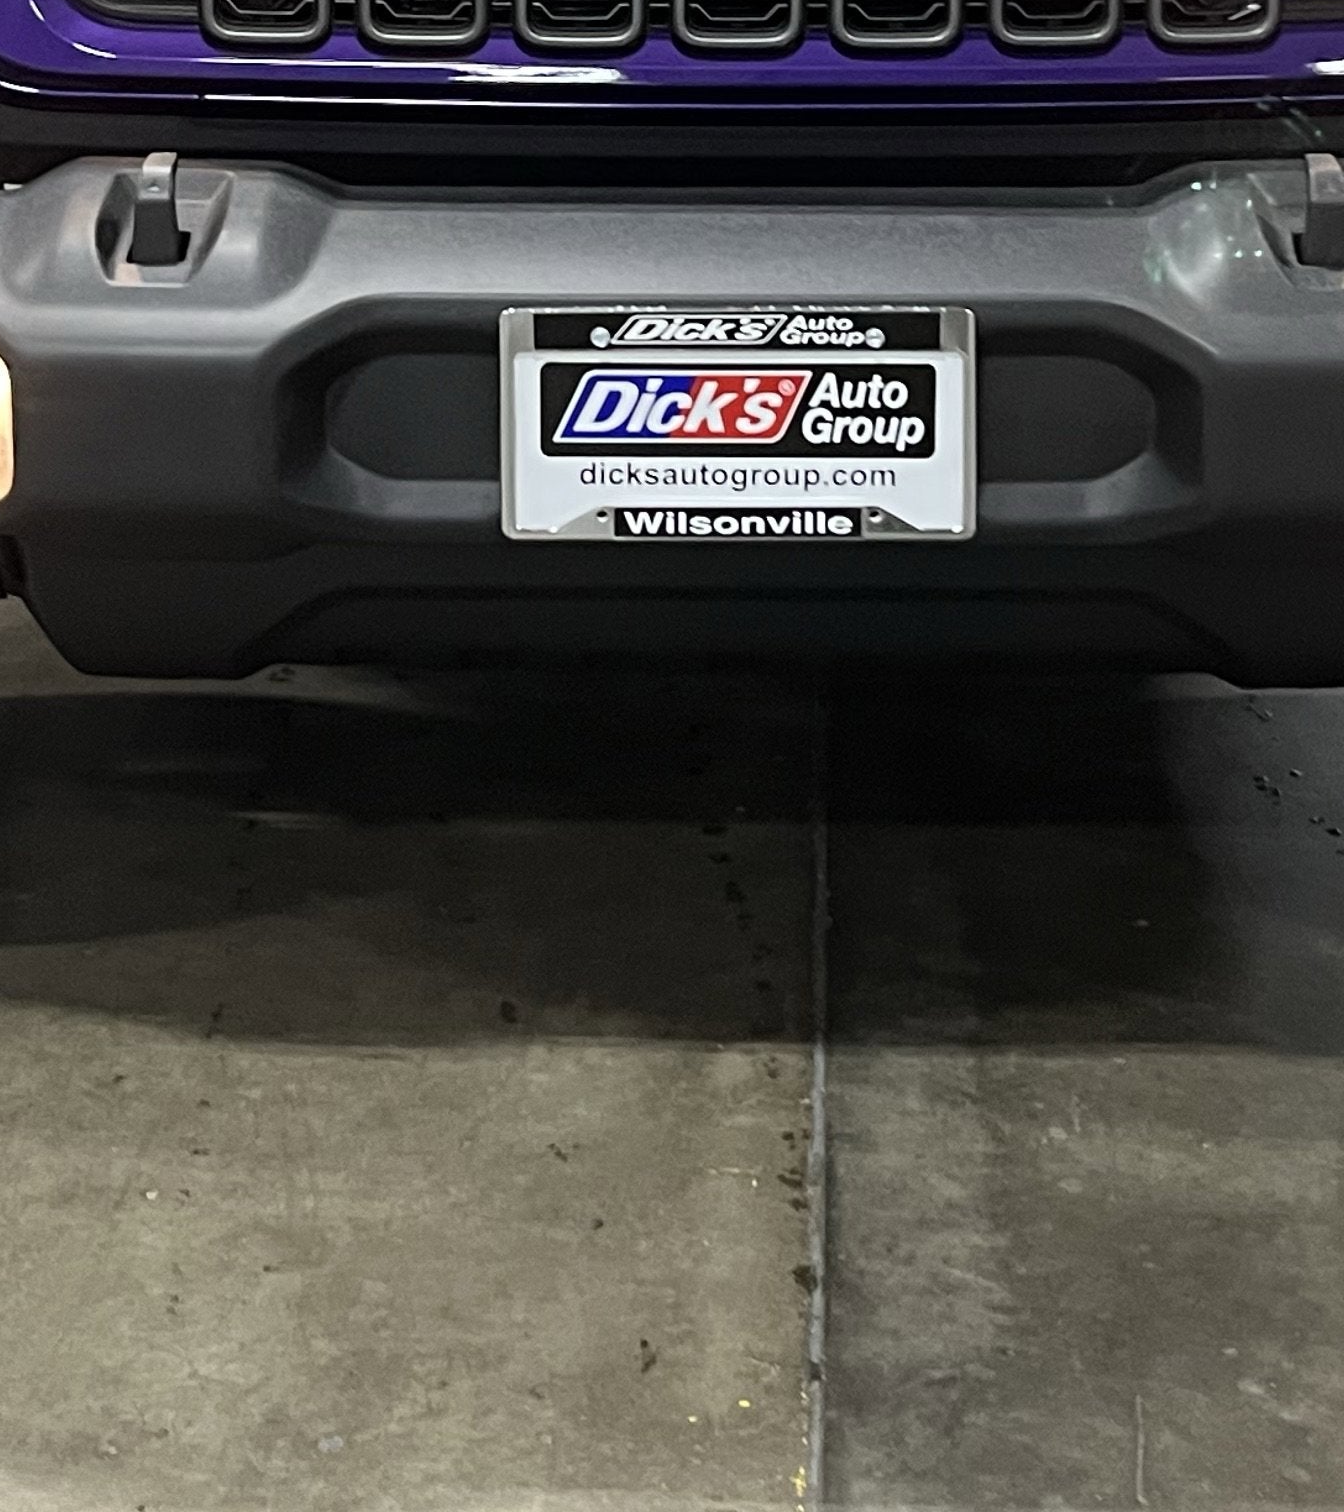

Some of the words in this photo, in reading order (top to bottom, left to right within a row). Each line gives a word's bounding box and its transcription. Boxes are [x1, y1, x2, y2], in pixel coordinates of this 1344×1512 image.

[791, 314, 854, 331] Auto
[779, 328, 866, 347] Group
[809, 373, 909, 410] Auto
[801, 409, 926, 452] Group
[579, 462, 897, 491] dicksautogroup.com
[623, 510, 854, 537] Wilsonville
